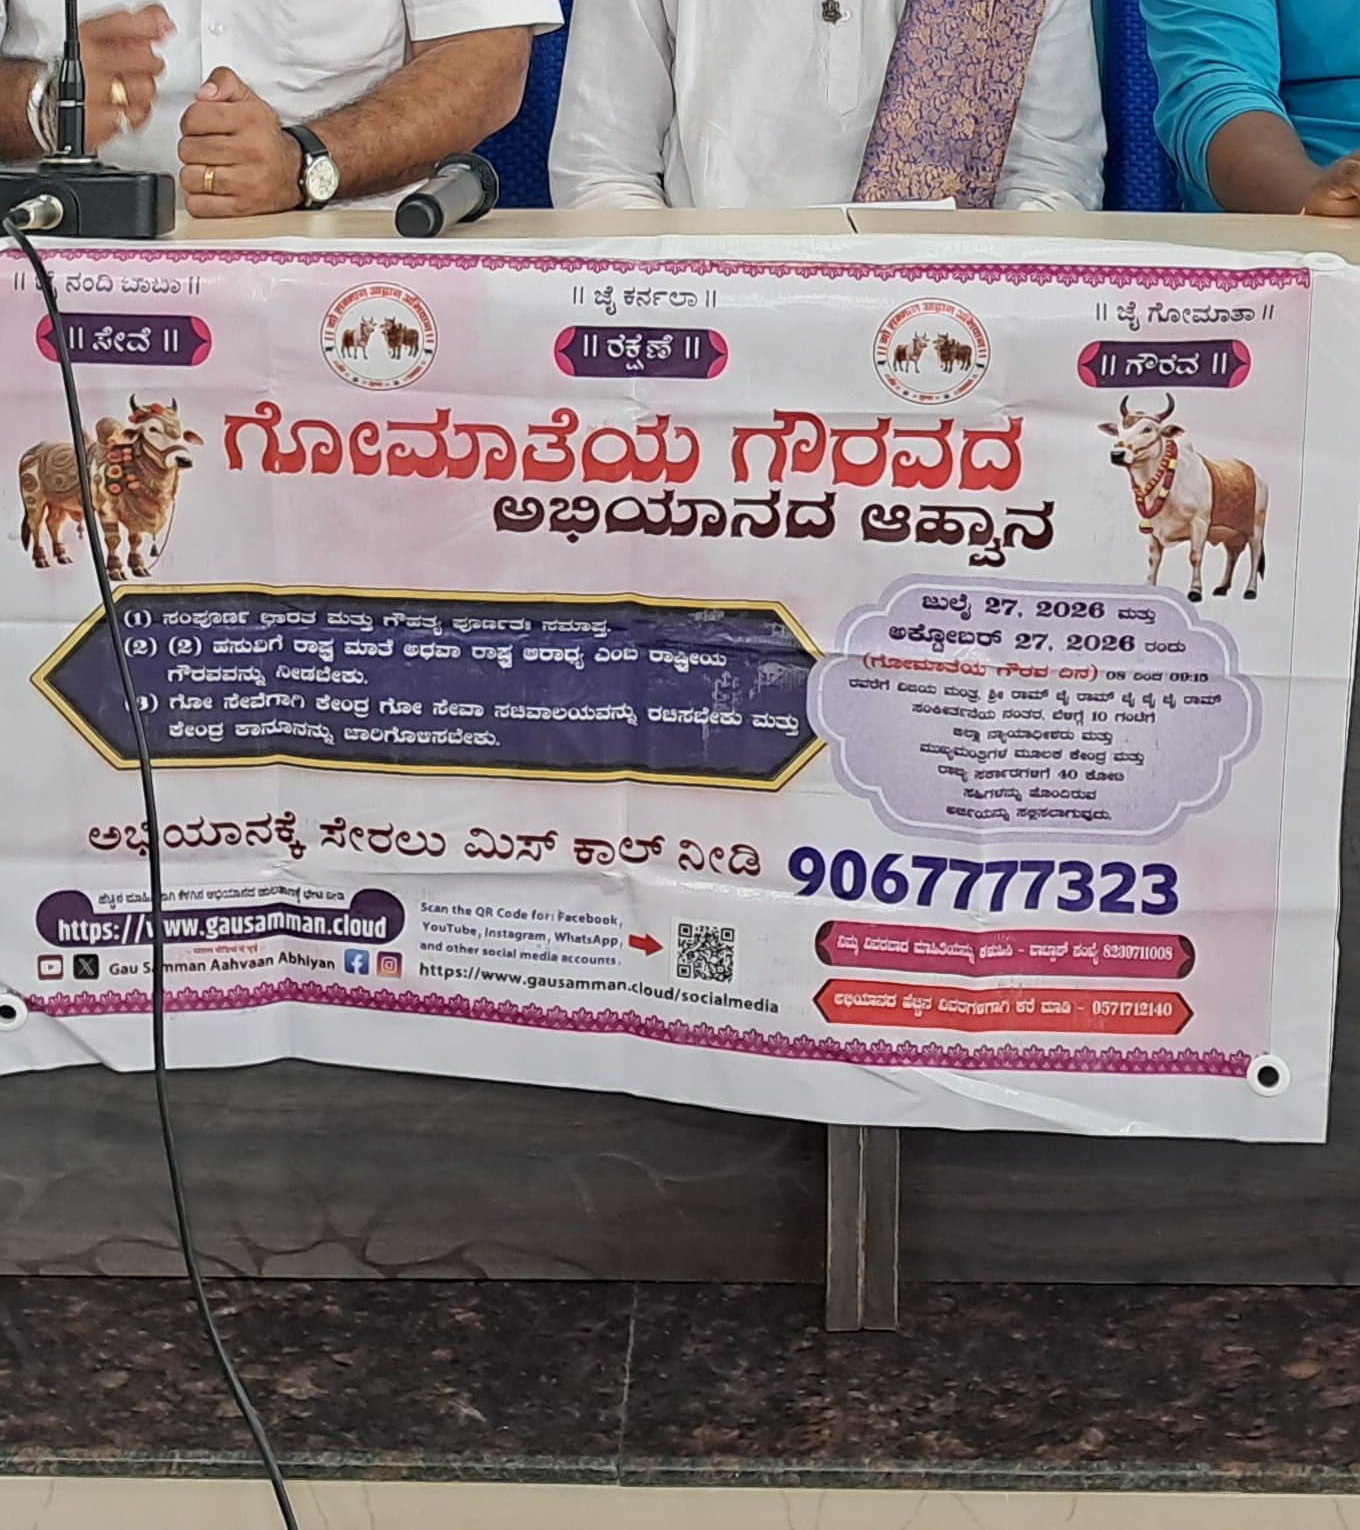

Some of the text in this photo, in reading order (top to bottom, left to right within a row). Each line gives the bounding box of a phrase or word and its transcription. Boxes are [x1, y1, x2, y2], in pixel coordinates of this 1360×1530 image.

[66, 272, 114, 294] ನಂದಿ
[121, 277, 181, 295] ಬಾಬಾ
[594, 285, 617, 316] ಜೈ
[1116, 300, 1255, 332] ಜೈ ಗೋಮಾತಾ
[92, 326, 152, 352] ಸೇವೆ
[606, 333, 674, 371] ರಕ್ಷಣೆ
[1124, 351, 1200, 377] ಗೌರವ
[223, 399, 1023, 492] ಗೋಮಾತೆಯ ಗೌರವದ
[492, 488, 1056, 568] ಅಭಿಯಾನದ ಆಹ್ವಾನ
[921, 593, 972, 621] ಜುಲೈ
[1035, 600, 1106, 620] 2026
[1118, 606, 1157, 625] ಮತ್ತು
[124, 610, 152, 629] (1)
[162, 610, 250, 628] ಸಂಪೂರ್ಣ
[260, 611, 316, 627] ಭಾರತ
[327, 611, 374, 632] ಮತ್ತು
[541, 618, 612, 638] ಸಮಾಪ್ತ.
[124, 636, 158, 657] (2)
[168, 636, 202, 657] (2)
[212, 634, 284, 654] ಹಸುವಿಗೆ
[344, 638, 394, 657] ಮಾತೆ
[403, 641, 462, 661] ಅಥವಾ
[594, 645, 639, 663] ಎಂಬ
[888, 623, 1003, 653] ಅಕ್ಟೋಬರ್
[1066, 633, 1136, 653] 2026
[1144, 640, 1187, 654] ರಂದು
[167, 664, 369, 687] ಗೌರವವನ್ನು ನೀಡಬೇಕು.
[862, 652, 987, 677] (ಗೋಮಾತೆಯ
[996, 662, 1049, 678] ಗೌರವ
[1105, 670, 1126, 681] 08
[169, 692, 213, 710] ಗೋ
[223, 691, 306, 710] ಸೇವೆಗಾಗಿ
[315, 694, 370, 718] ಕೇಂದ್ರ
[379, 697, 423, 715] ಗೋ
[432, 698, 485, 718] ಸೇವಾ
[493, 702, 638, 726] ಸಚಿವಾಲಯವನ್ನು
[647, 705, 742, 726] ರಚಿಸಬೇಕು
[752, 712, 800, 736] ಮತ್ತು
[1092, 711, 1108, 722] 10
[168, 721, 224, 742] ಕೇಂದ್ರ
[235, 718, 335, 745] ಕಾನೂನನ್ನು
[1057, 769, 1078, 780] 40
[319, 816, 446, 858] ಸೇರಲು
[464, 826, 559, 862] ಮಿಸ್
[573, 834, 666, 866] ಕಾಲ್
[678, 838, 762, 876] ನೀಡಿ
[787, 845, 1179, 916] 9067777323
[421, 902, 448, 914] Scan
[452, 906, 472, 916] the
[475, 907, 493, 918] QR
[497, 908, 528, 920] Code
[422, 922, 624, 948] YouTube, Instagram, WhatsApp,
[109, 952, 336, 975] Gau Smman Aahvaan Abhiyan
[420, 941, 442, 952] and
[446, 944, 479, 954] other
[482, 947, 516, 958] social
[520, 950, 558, 962] media
[418, 962, 780, 1015] https://www.gausamman.cloud/socialmedia
